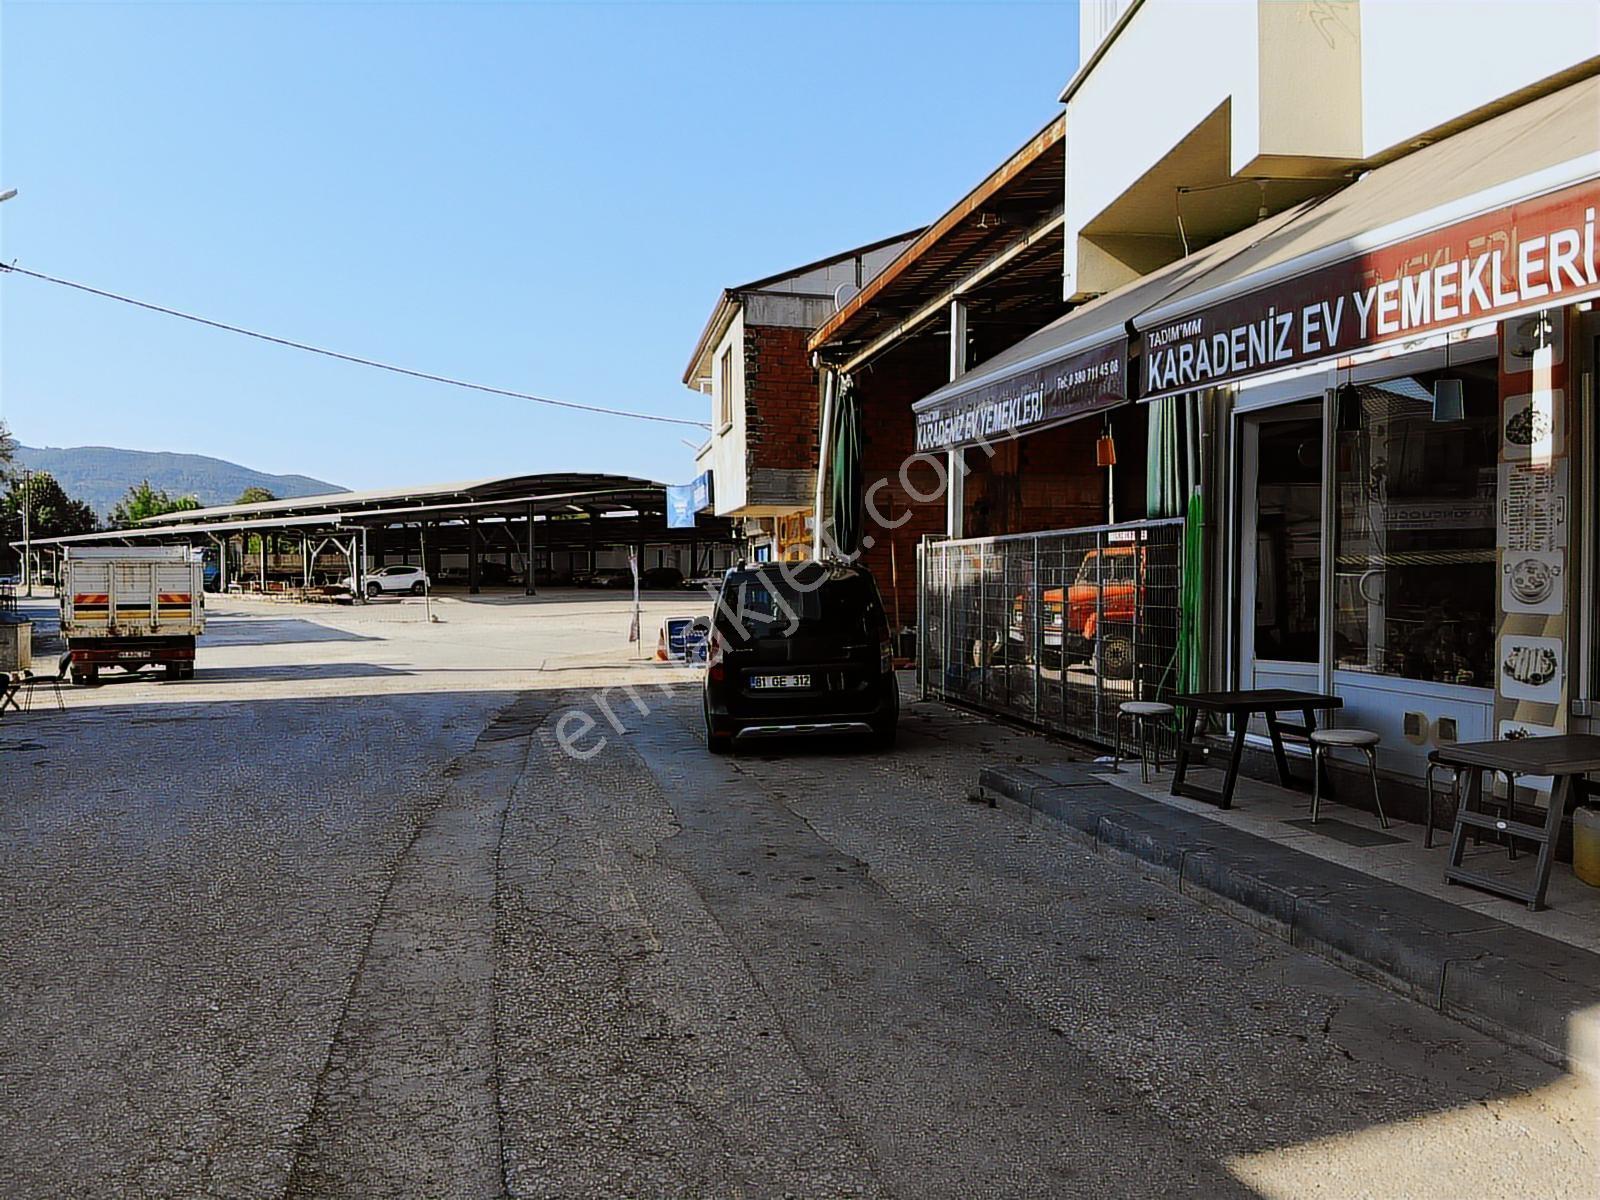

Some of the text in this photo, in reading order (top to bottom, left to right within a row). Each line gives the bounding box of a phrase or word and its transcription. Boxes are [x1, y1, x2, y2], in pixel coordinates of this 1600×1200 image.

[1147, 306, 1293, 392] KARADENİZ
[1302, 296, 1345, 354] EV
[1352, 207, 1598, 340] YEMEKLERİ
[1149, 318, 1202, 348] TADIM'MM
[1087, 365, 1099, 382] 711
[916, 381, 1045, 451] KARADENİZ EV YEMEKLERİ
[793, 675, 810, 687] 312
